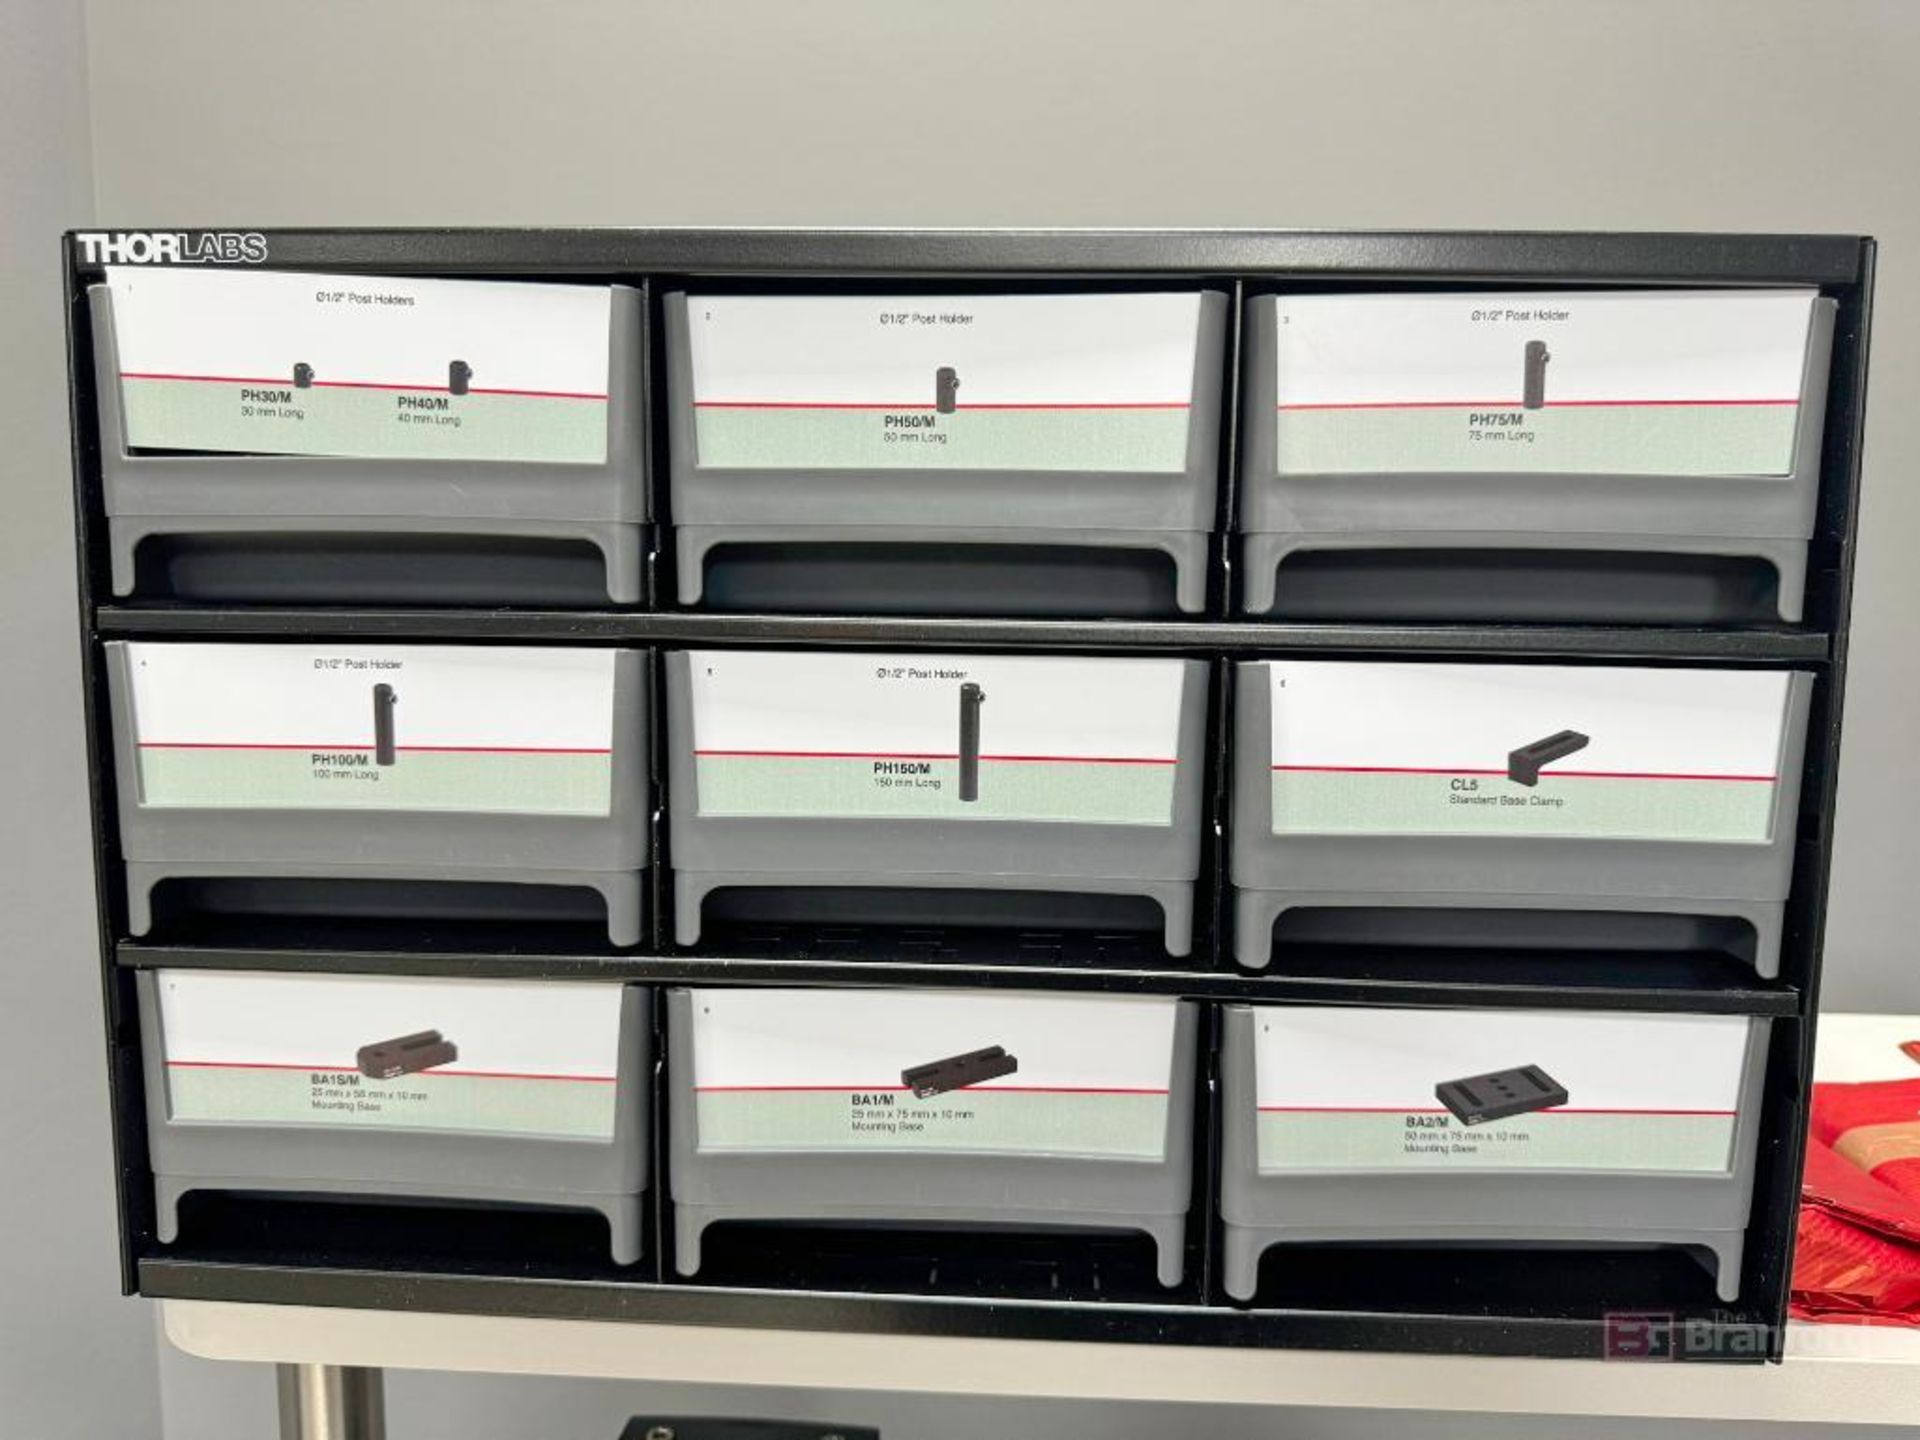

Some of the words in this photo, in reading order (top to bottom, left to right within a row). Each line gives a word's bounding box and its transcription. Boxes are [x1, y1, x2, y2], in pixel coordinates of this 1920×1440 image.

[76, 232, 267, 263] THORLABS
[348, 292, 372, 304] Post
[374, 293, 415, 306] Holders
[912, 313, 936, 325] Post
[939, 313, 973, 325] Holder
[1505, 309, 1530, 321] Post
[1533, 309, 1570, 321] Holder
[241, 389, 292, 403] PH30/M
[398, 396, 449, 410] PH40/M
[241, 405, 254, 417] 30
[256, 407, 276, 417] mm
[278, 406, 304, 420] Long
[398, 413, 410, 423] 40
[413, 415, 433, 424] mm
[436, 414, 461, 427] Long
[885, 415, 936, 428] PH50/M
[1469, 413, 1524, 427] PH75/M
[900, 433, 919, 442] mm
[922, 431, 947, 445] Long
[1469, 430, 1482, 441] 75
[1485, 432, 1504, 441] mm
[1507, 430, 1535, 443] Long
[345, 658, 368, 670] Post
[370, 658, 403, 670] Holder
[908, 667, 933, 679] Post
[934, 668, 968, 679] Holder
[312, 753, 368, 766] PH100/M
[874, 762, 931, 775] PH150/M
[313, 769, 331, 779] 100
[333, 771, 351, 780] mm
[354, 770, 379, 782] Long
[875, 778, 892, 788] 150
[895, 780, 913, 788] mm
[915, 778, 941, 790] Long
[1451, 778, 1478, 791] CL5
[1449, 794, 1498, 805] Standard
[1500, 795, 1527, 806] Base
[1530, 795, 1564, 808] Clamp
[311, 1074, 360, 1086] BA1S/M
[312, 1099, 355, 1112] Mounting
[359, 1100, 382, 1112] Base
[852, 1094, 894, 1106] BA1/M
[866, 1110, 885, 1119] mm
[896, 1109, 909, 1119] 75
[910, 1110, 930, 1119] mm
[954, 1110, 974, 1120] mm
[852, 1121, 896, 1134] Mounting
[899, 1121, 925, 1132] Base
[1406, 1115, 1448, 1128] BA2/M
[1419, 1132, 1439, 1141] mm
[1464, 1132, 1485, 1142] mm
[1510, 1132, 1529, 1142] mm
[1403, 1143, 1448, 1155] Mounting
